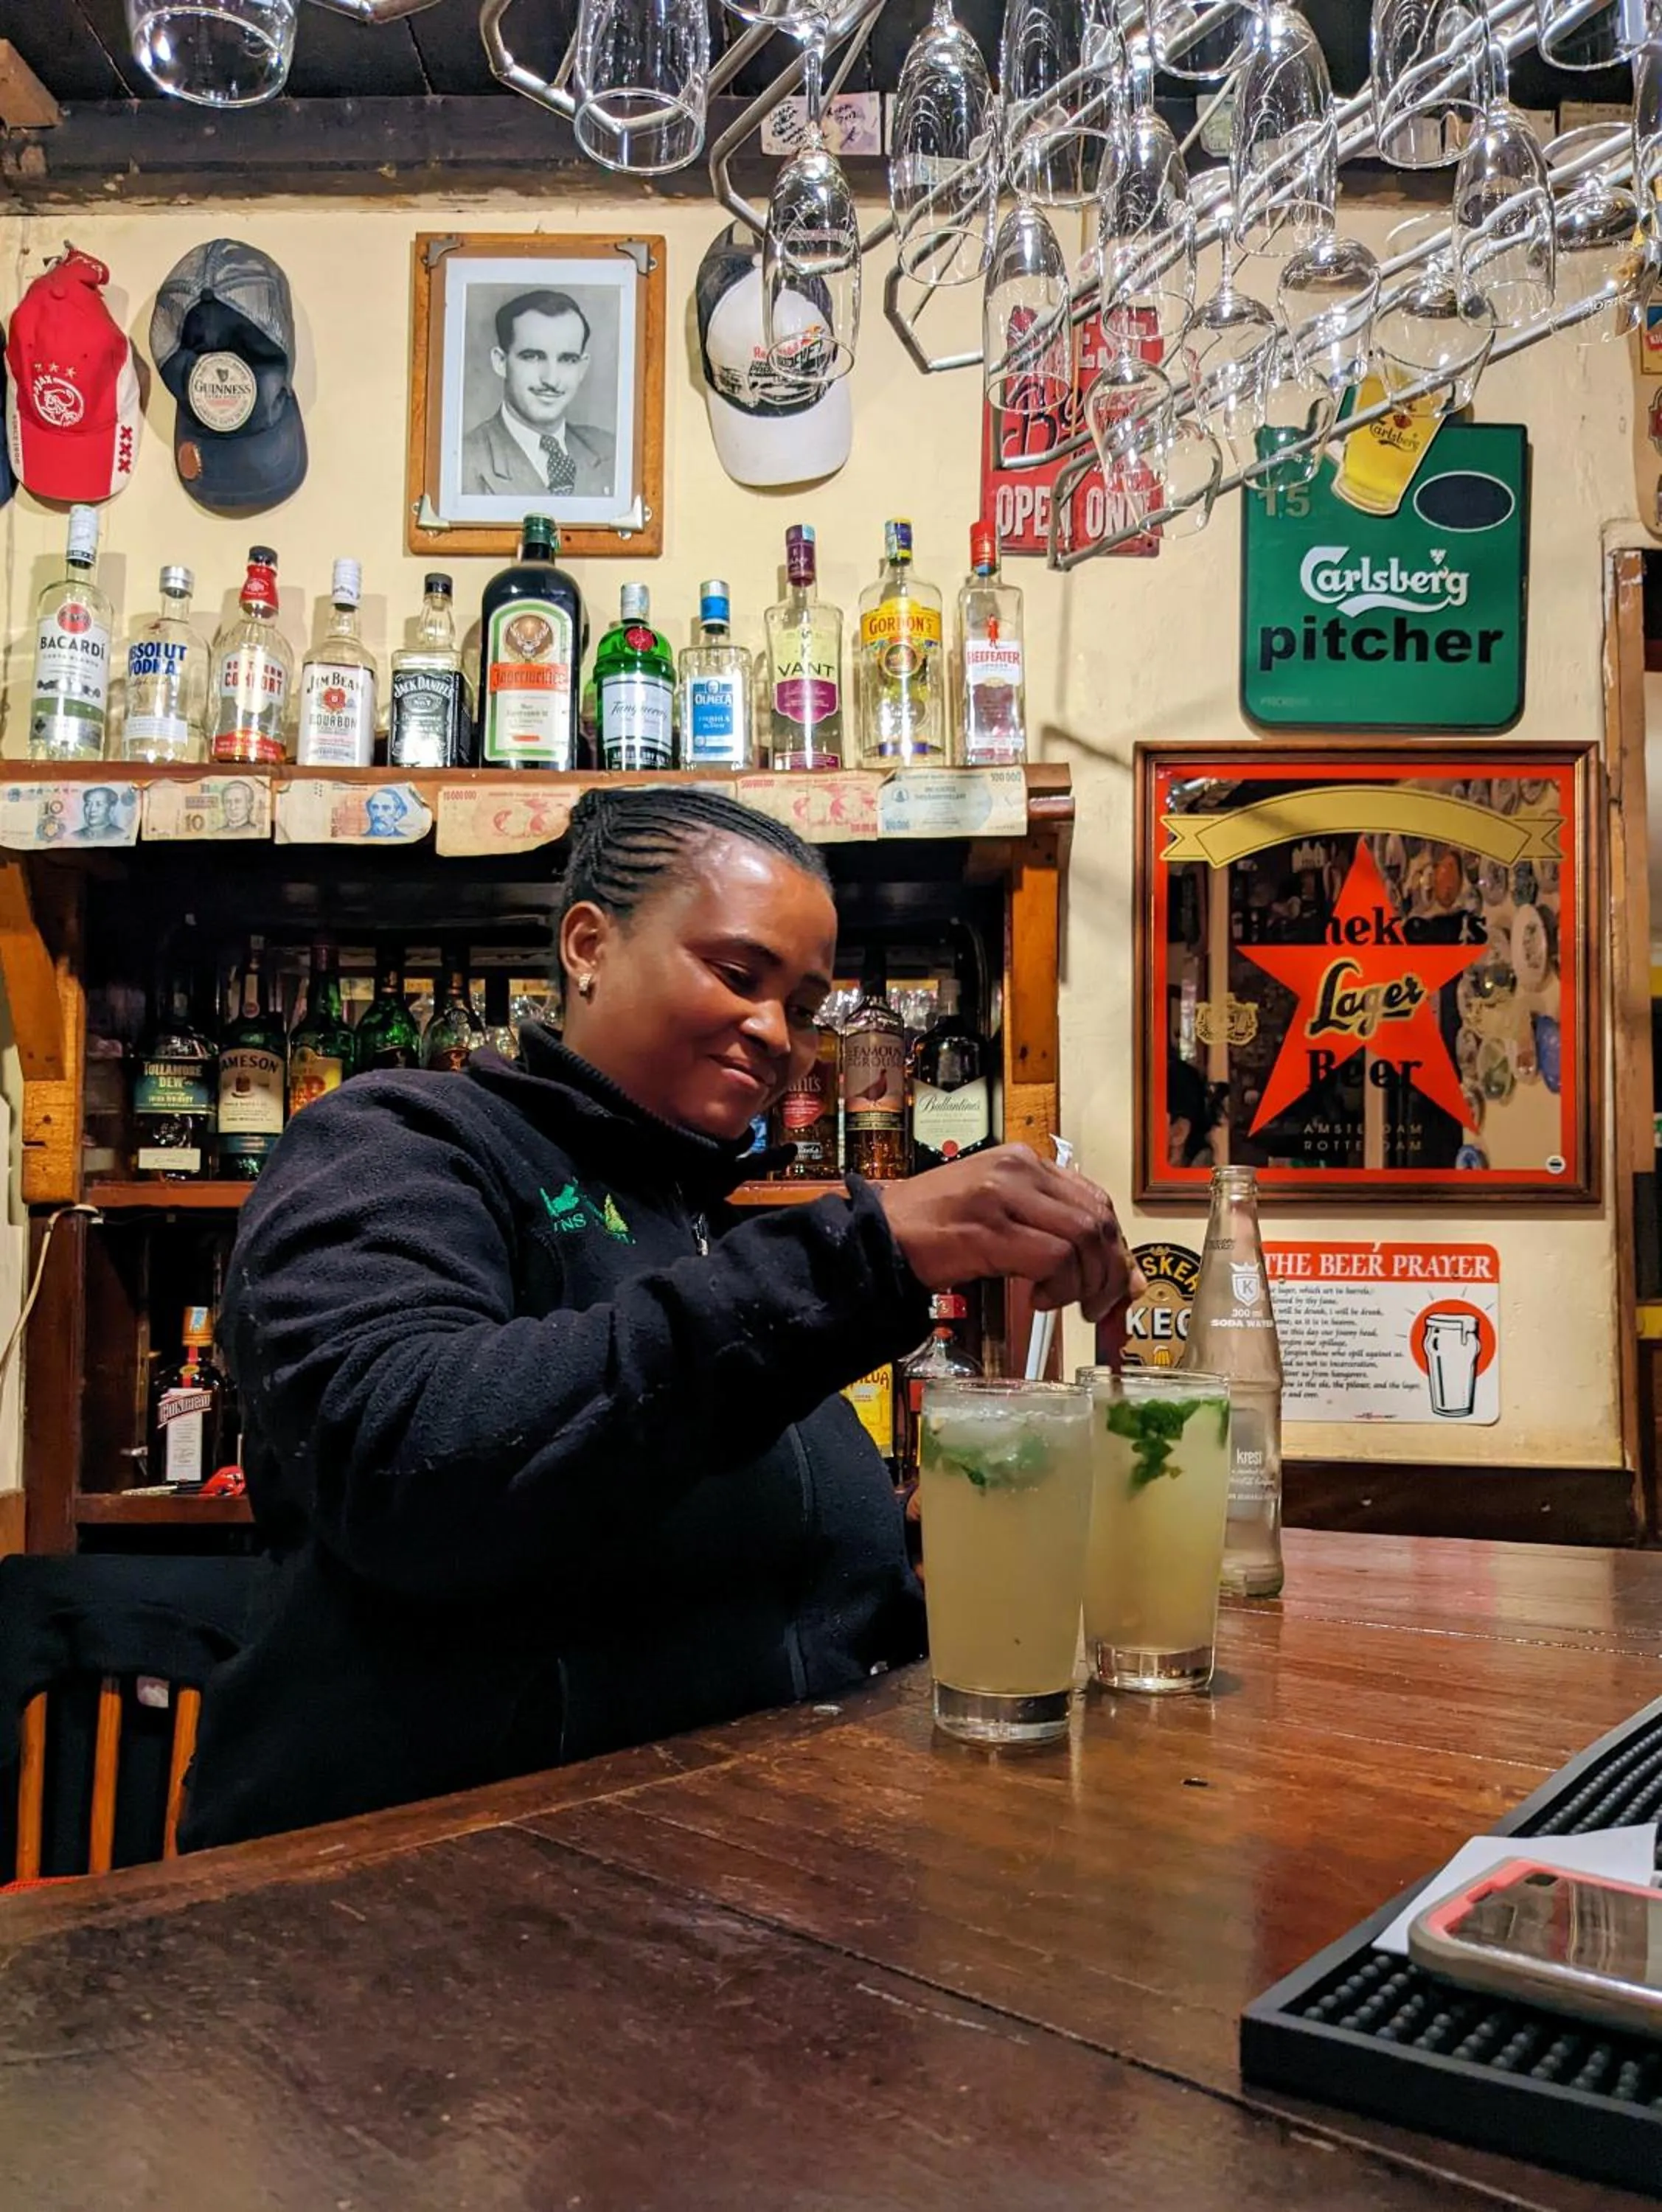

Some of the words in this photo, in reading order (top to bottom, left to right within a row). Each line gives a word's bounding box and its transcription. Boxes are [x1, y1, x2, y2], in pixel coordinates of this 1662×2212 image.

[194, 379, 251, 394] GUINNESS
[1300, 546, 1470, 611] Carlsberg
[129, 641, 188, 661] BSOLUT
[1259, 616, 1504, 671] pitcher
[225, 672, 282, 695] COORT
[1306, 958, 1428, 1039] Lager
[221, 1054, 278, 1074] AMESON
[1305, 1048, 1424, 1091] Beer
[788, 1074, 822, 1092] ant's
[1304, 1123, 1423, 1135] AMSTEDAM
[1304, 1141, 1423, 1152] ROTTEDAM
[1143, 1256, 1200, 1292] SKER
[1265, 1253, 1311, 1276] THE
[1320, 1253, 1385, 1276] BEER
[1392, 1255, 1493, 1279] PRAYER
[1242, 1279, 1253, 1294] K
[1210, 1319, 1244, 1327] SODA
[1231, 1309, 1250, 1318] 300
[858, 1371, 889, 1391] LUA
